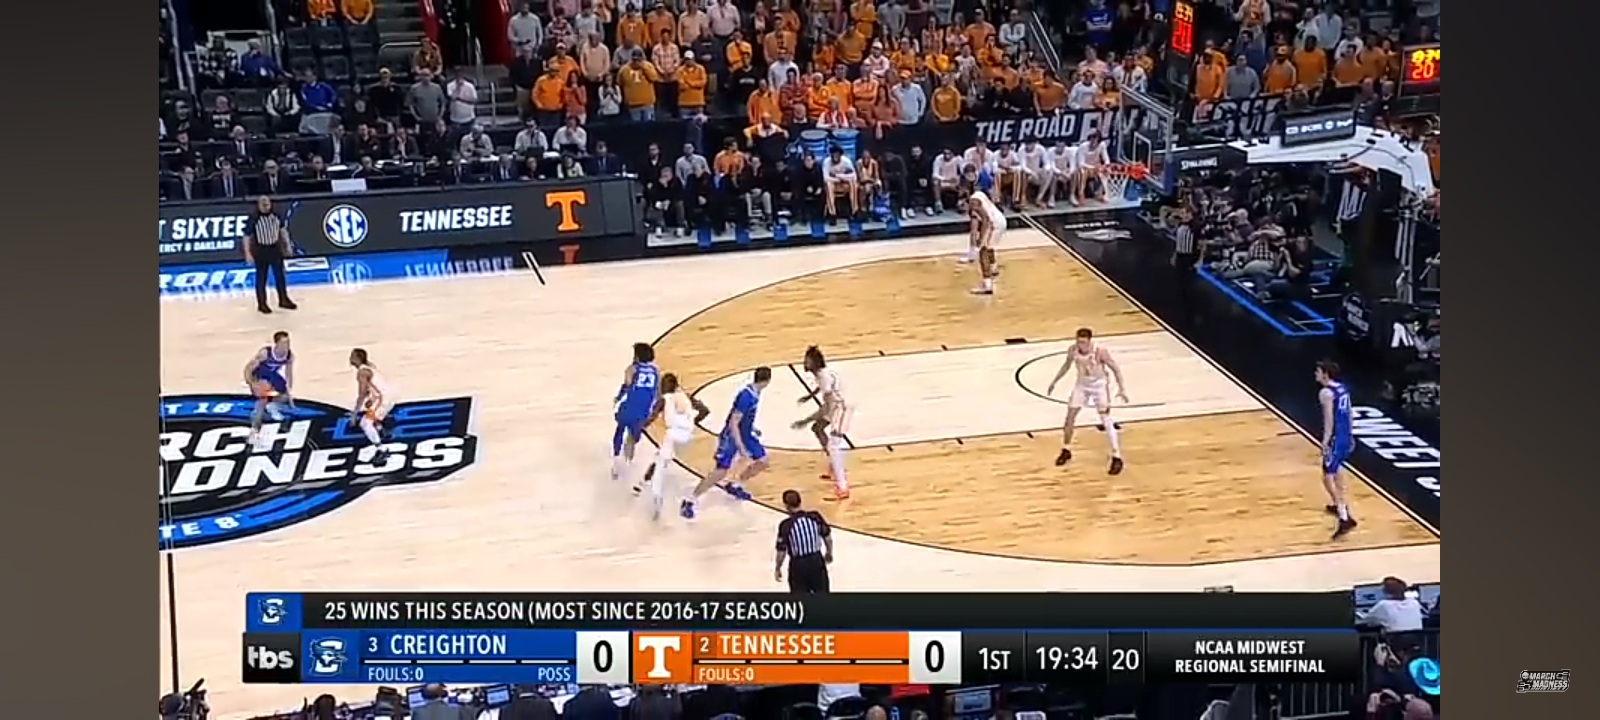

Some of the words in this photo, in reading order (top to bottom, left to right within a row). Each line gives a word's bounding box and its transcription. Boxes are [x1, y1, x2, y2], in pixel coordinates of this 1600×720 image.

[1412, 63, 1434, 79] 20
[976, 121, 1012, 142] THE
[1018, 114, 1076, 140] ROAD
[400, 205, 512, 232] TENNESSEE
[545, 191, 586, 231] T
[325, 207, 365, 244] SEC
[636, 371, 656, 388] 23
[159, 437, 465, 494] DNESS
[214, 516, 238, 529] 8
